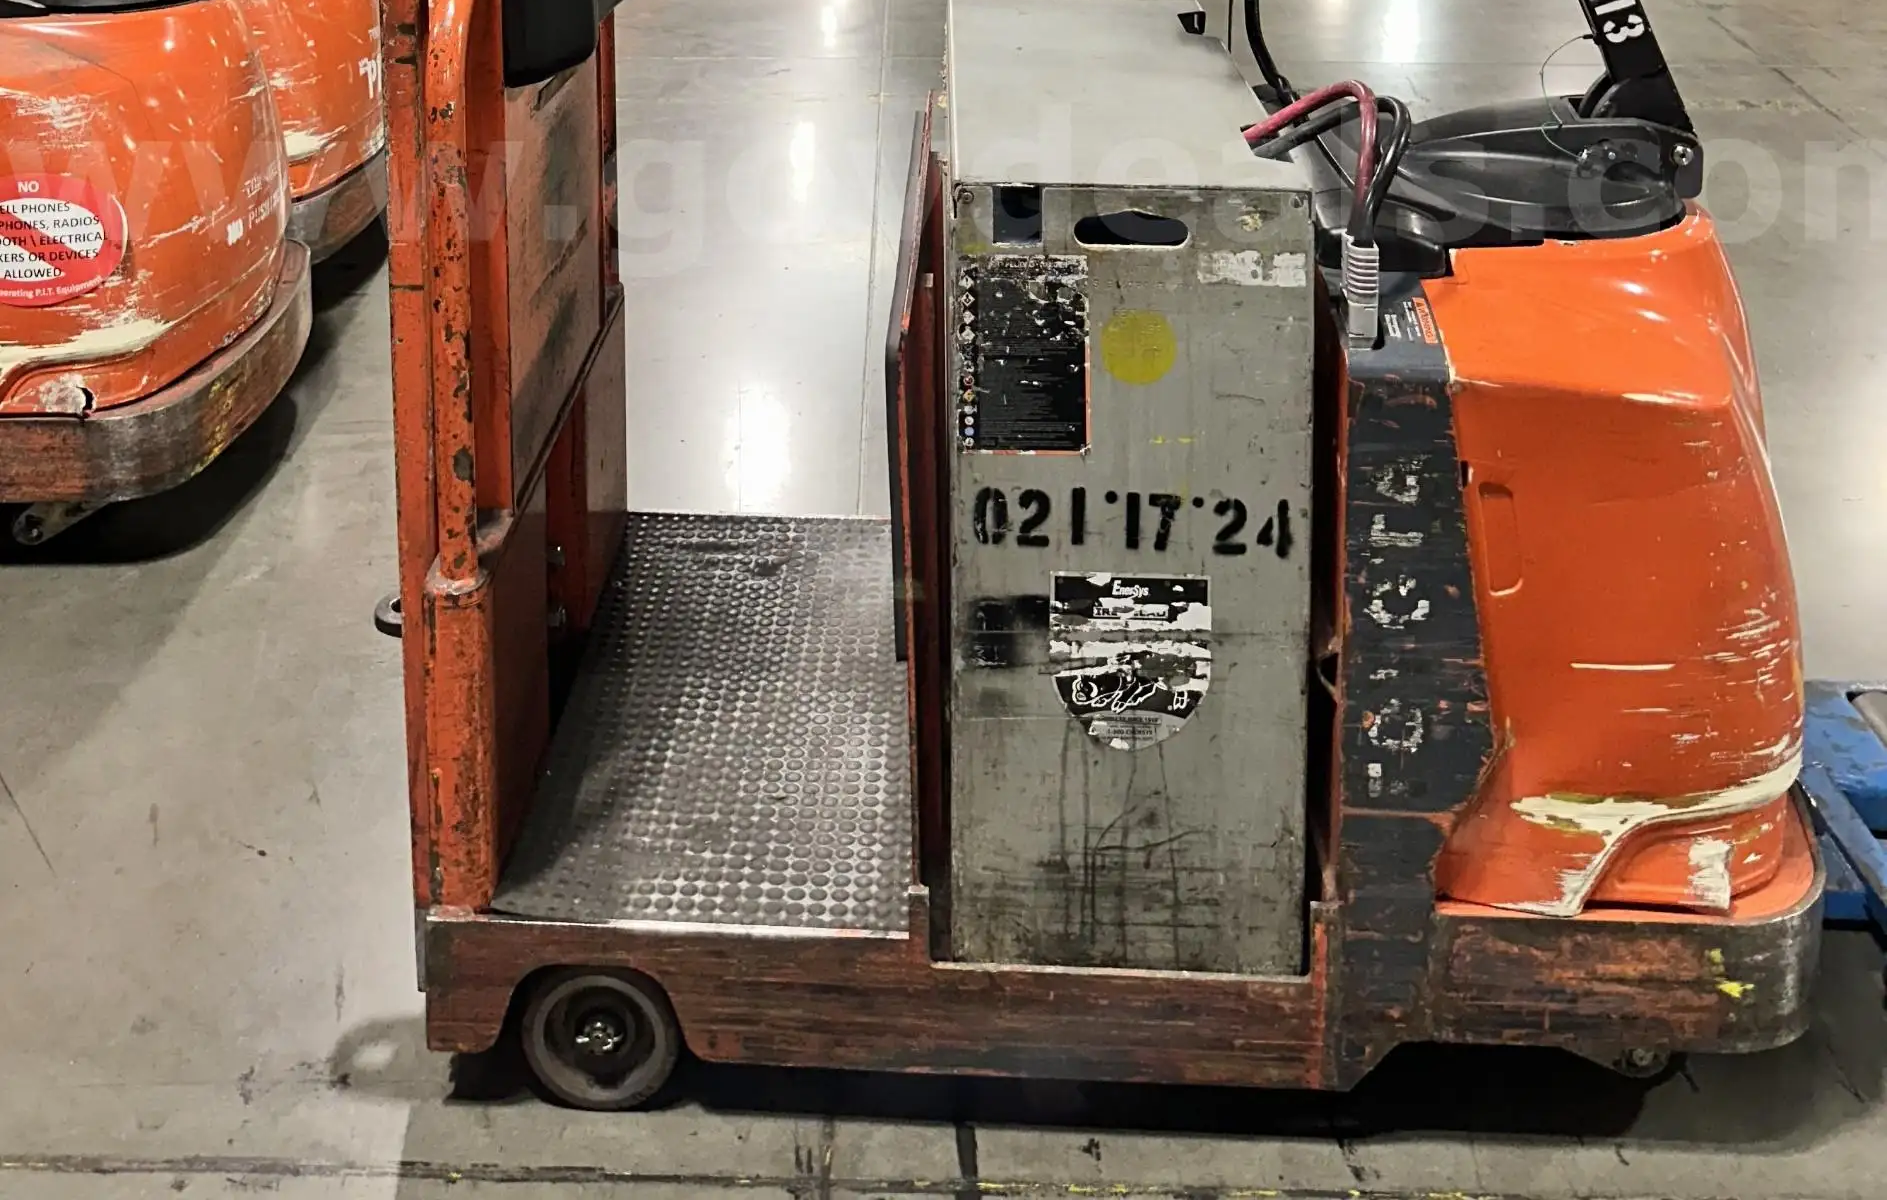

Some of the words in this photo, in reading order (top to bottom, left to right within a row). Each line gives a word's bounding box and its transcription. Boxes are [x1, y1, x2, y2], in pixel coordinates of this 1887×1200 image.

[17, 180, 40, 192] NO
[21, 201, 70, 213] PHONES
[53, 215, 100, 229] RADIOS
[0, 235, 27, 247] OTH
[40, 230, 108, 246] ELECTRICAL
[28, 251, 46, 262] OR
[49, 248, 100, 260] DEVICES
[4, 267, 62, 279] ALLOWED
[56, 274, 103, 295] Equipment
